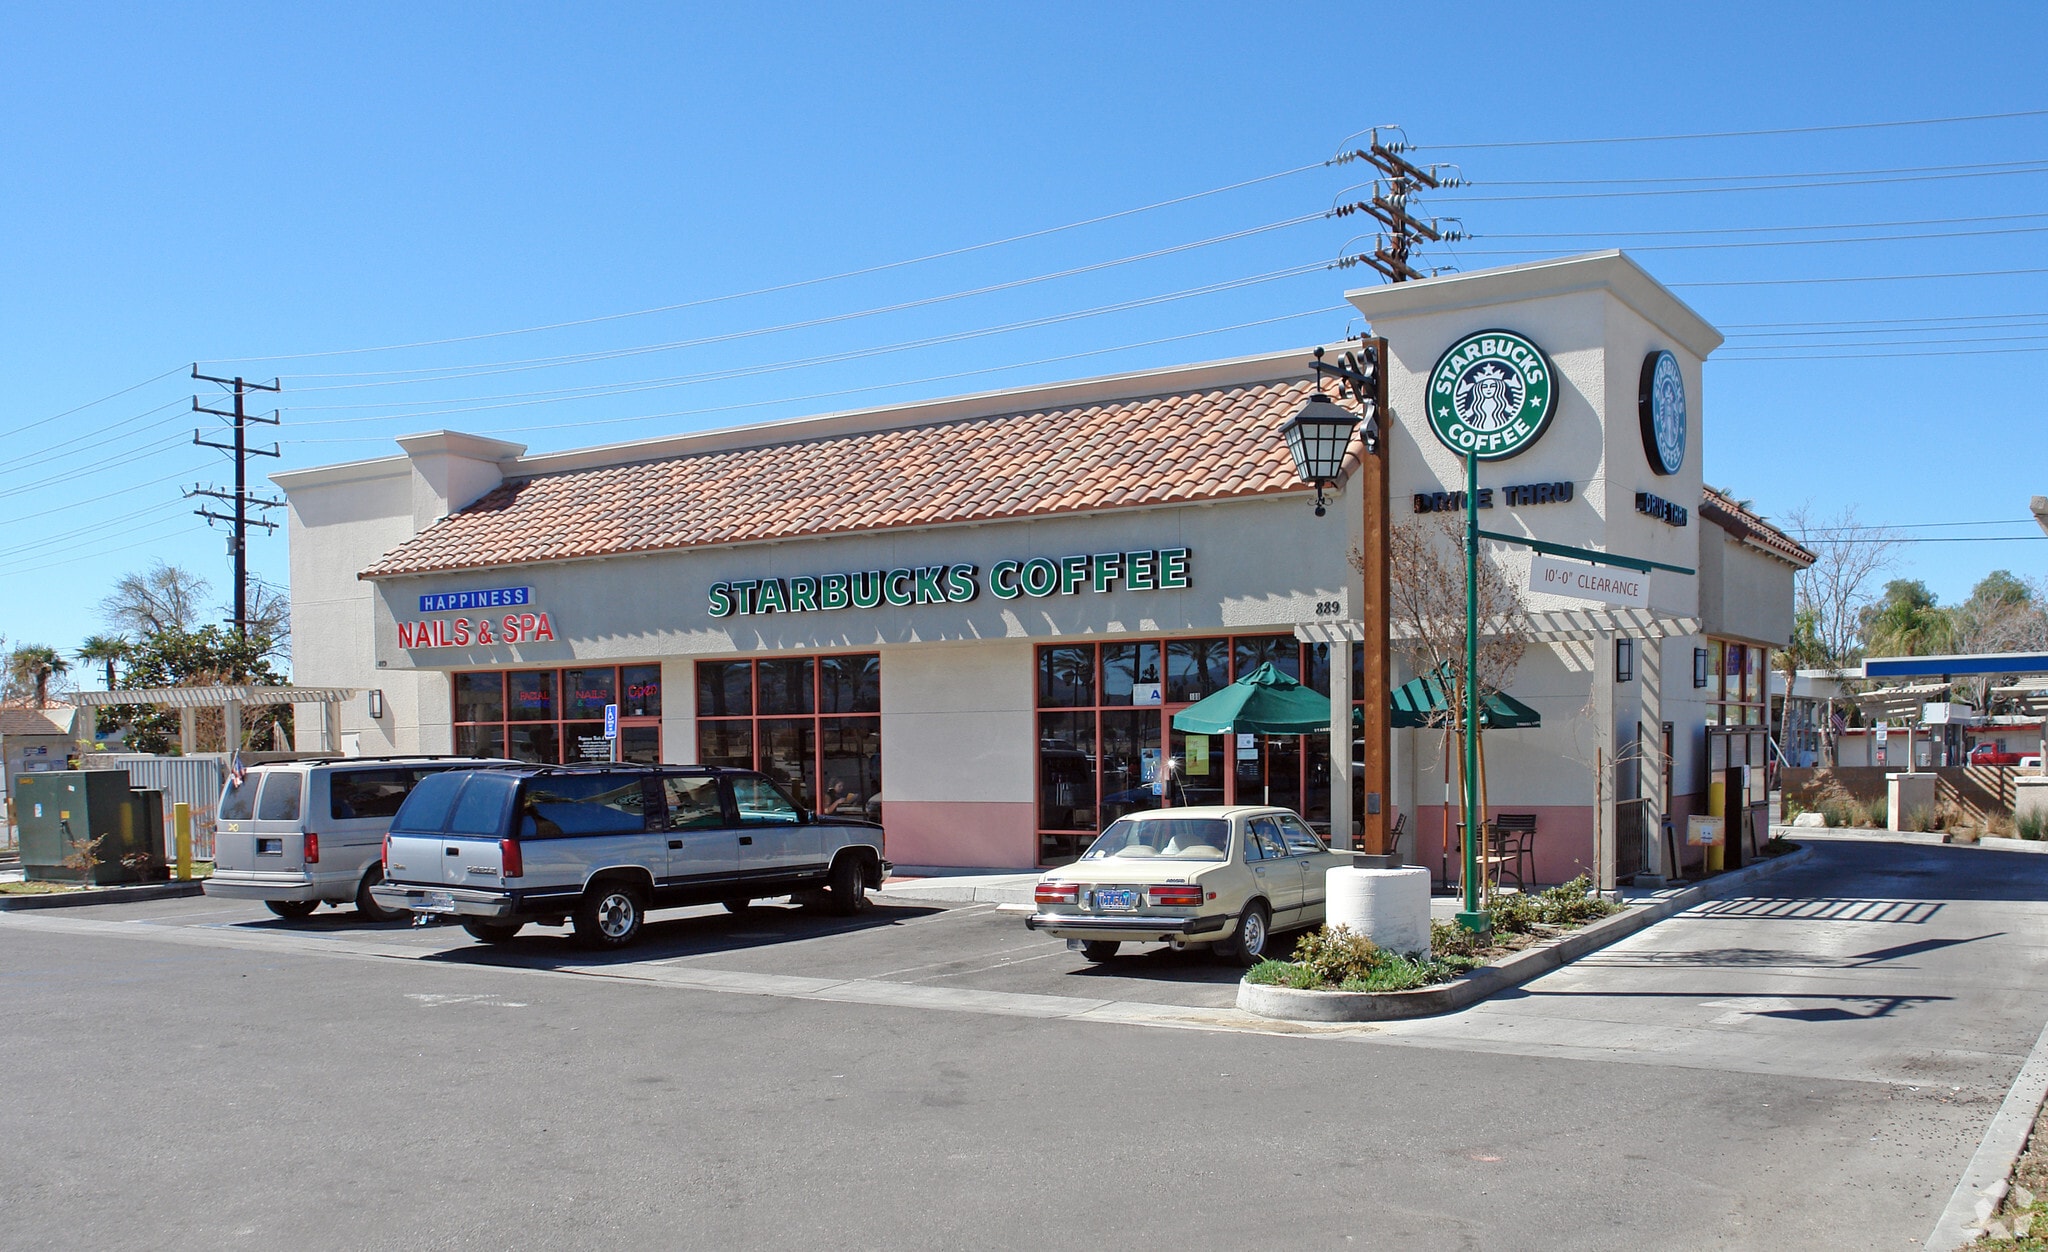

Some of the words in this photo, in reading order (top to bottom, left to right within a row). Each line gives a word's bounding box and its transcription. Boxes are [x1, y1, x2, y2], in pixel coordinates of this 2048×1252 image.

[1435, 338, 1544, 396] STARBUCKS
[1654, 359, 1685, 414] STARBUCKS
[1448, 417, 1531, 451] COFFEE
[1658, 432, 1681, 466] COFFEE
[1502, 481, 1574, 507] THRU
[1645, 494, 1667, 520] DRIVE
[1670, 503, 1687, 526] THRU
[708, 563, 974, 618] STARBUCKS
[989, 547, 1188, 599] COFFEE
[1577, 573, 1639, 598] CLEARANCE
[424, 588, 524, 610] HAPPINESS
[1315, 601, 1340, 615] 889
[398, 617, 470, 649] NAILS
[478, 620, 493, 645] &
[502, 612, 555, 643] SPA
[575, 689, 607, 698] NAILS
[1150, 689, 1161, 700] A
